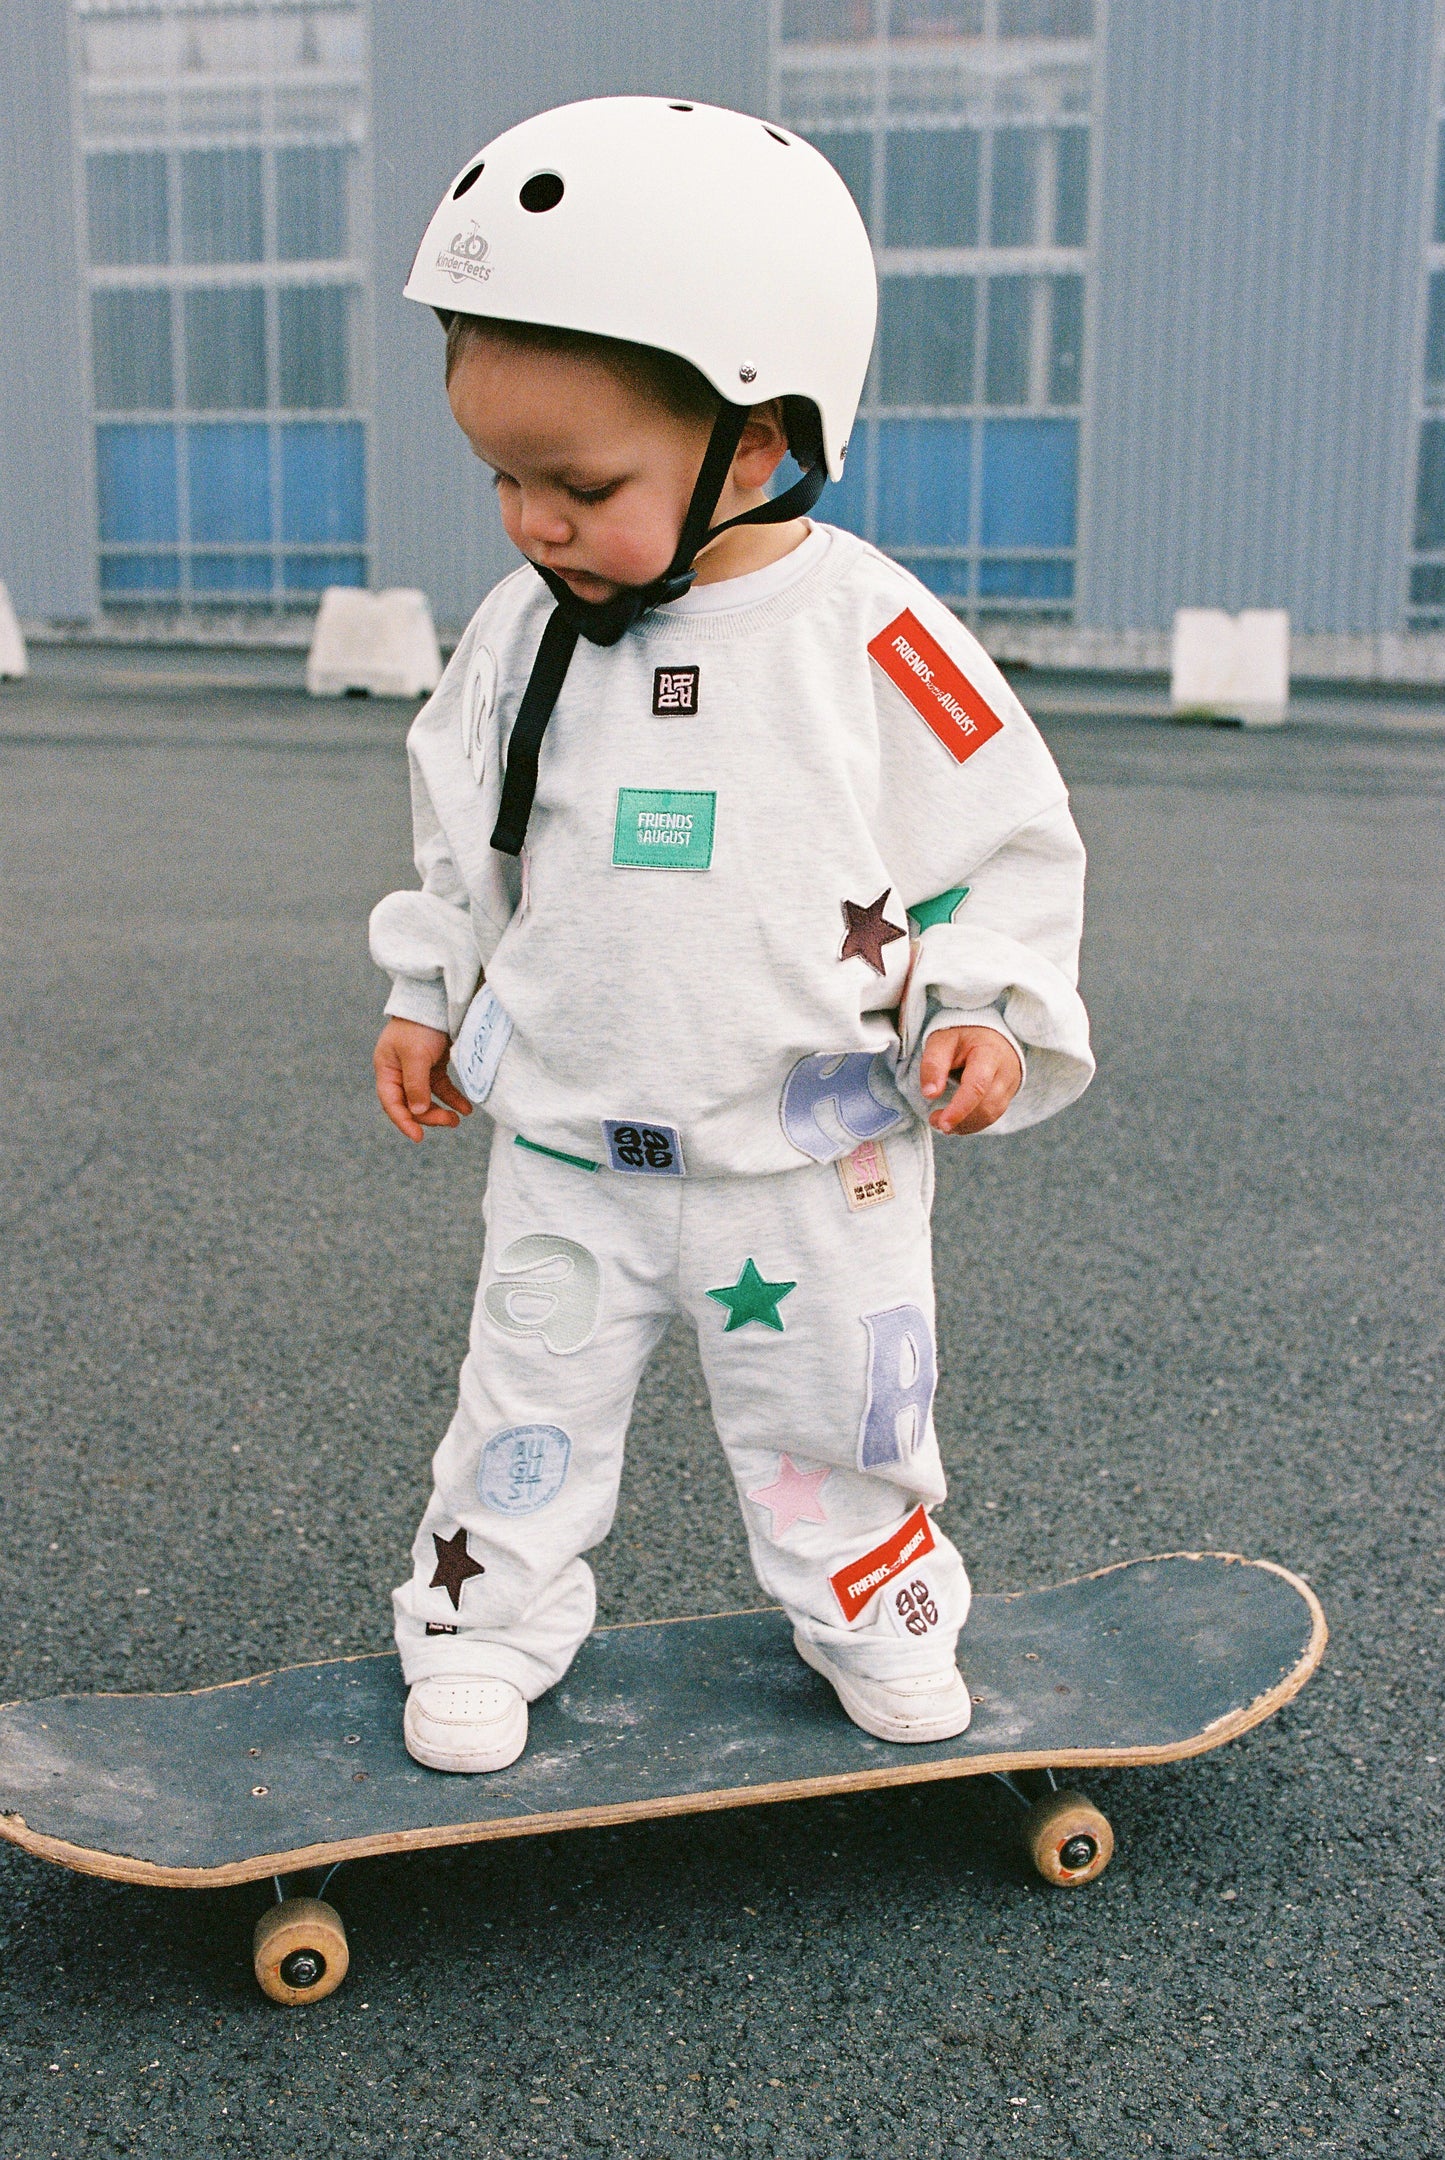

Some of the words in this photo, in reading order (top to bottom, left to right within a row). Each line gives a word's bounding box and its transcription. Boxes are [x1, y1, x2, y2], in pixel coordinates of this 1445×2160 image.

[436, 251, 491, 281] kinderfeets
[891, 635, 934, 683] FRIENDS
[938, 692, 978, 737] AUGUST
[638, 812, 694, 829] FRIENDS
[643, 830, 691, 847] AUGUST
[847, 1563, 890, 1599] FRIENDS
[899, 1528, 926, 1564] AUGUST
